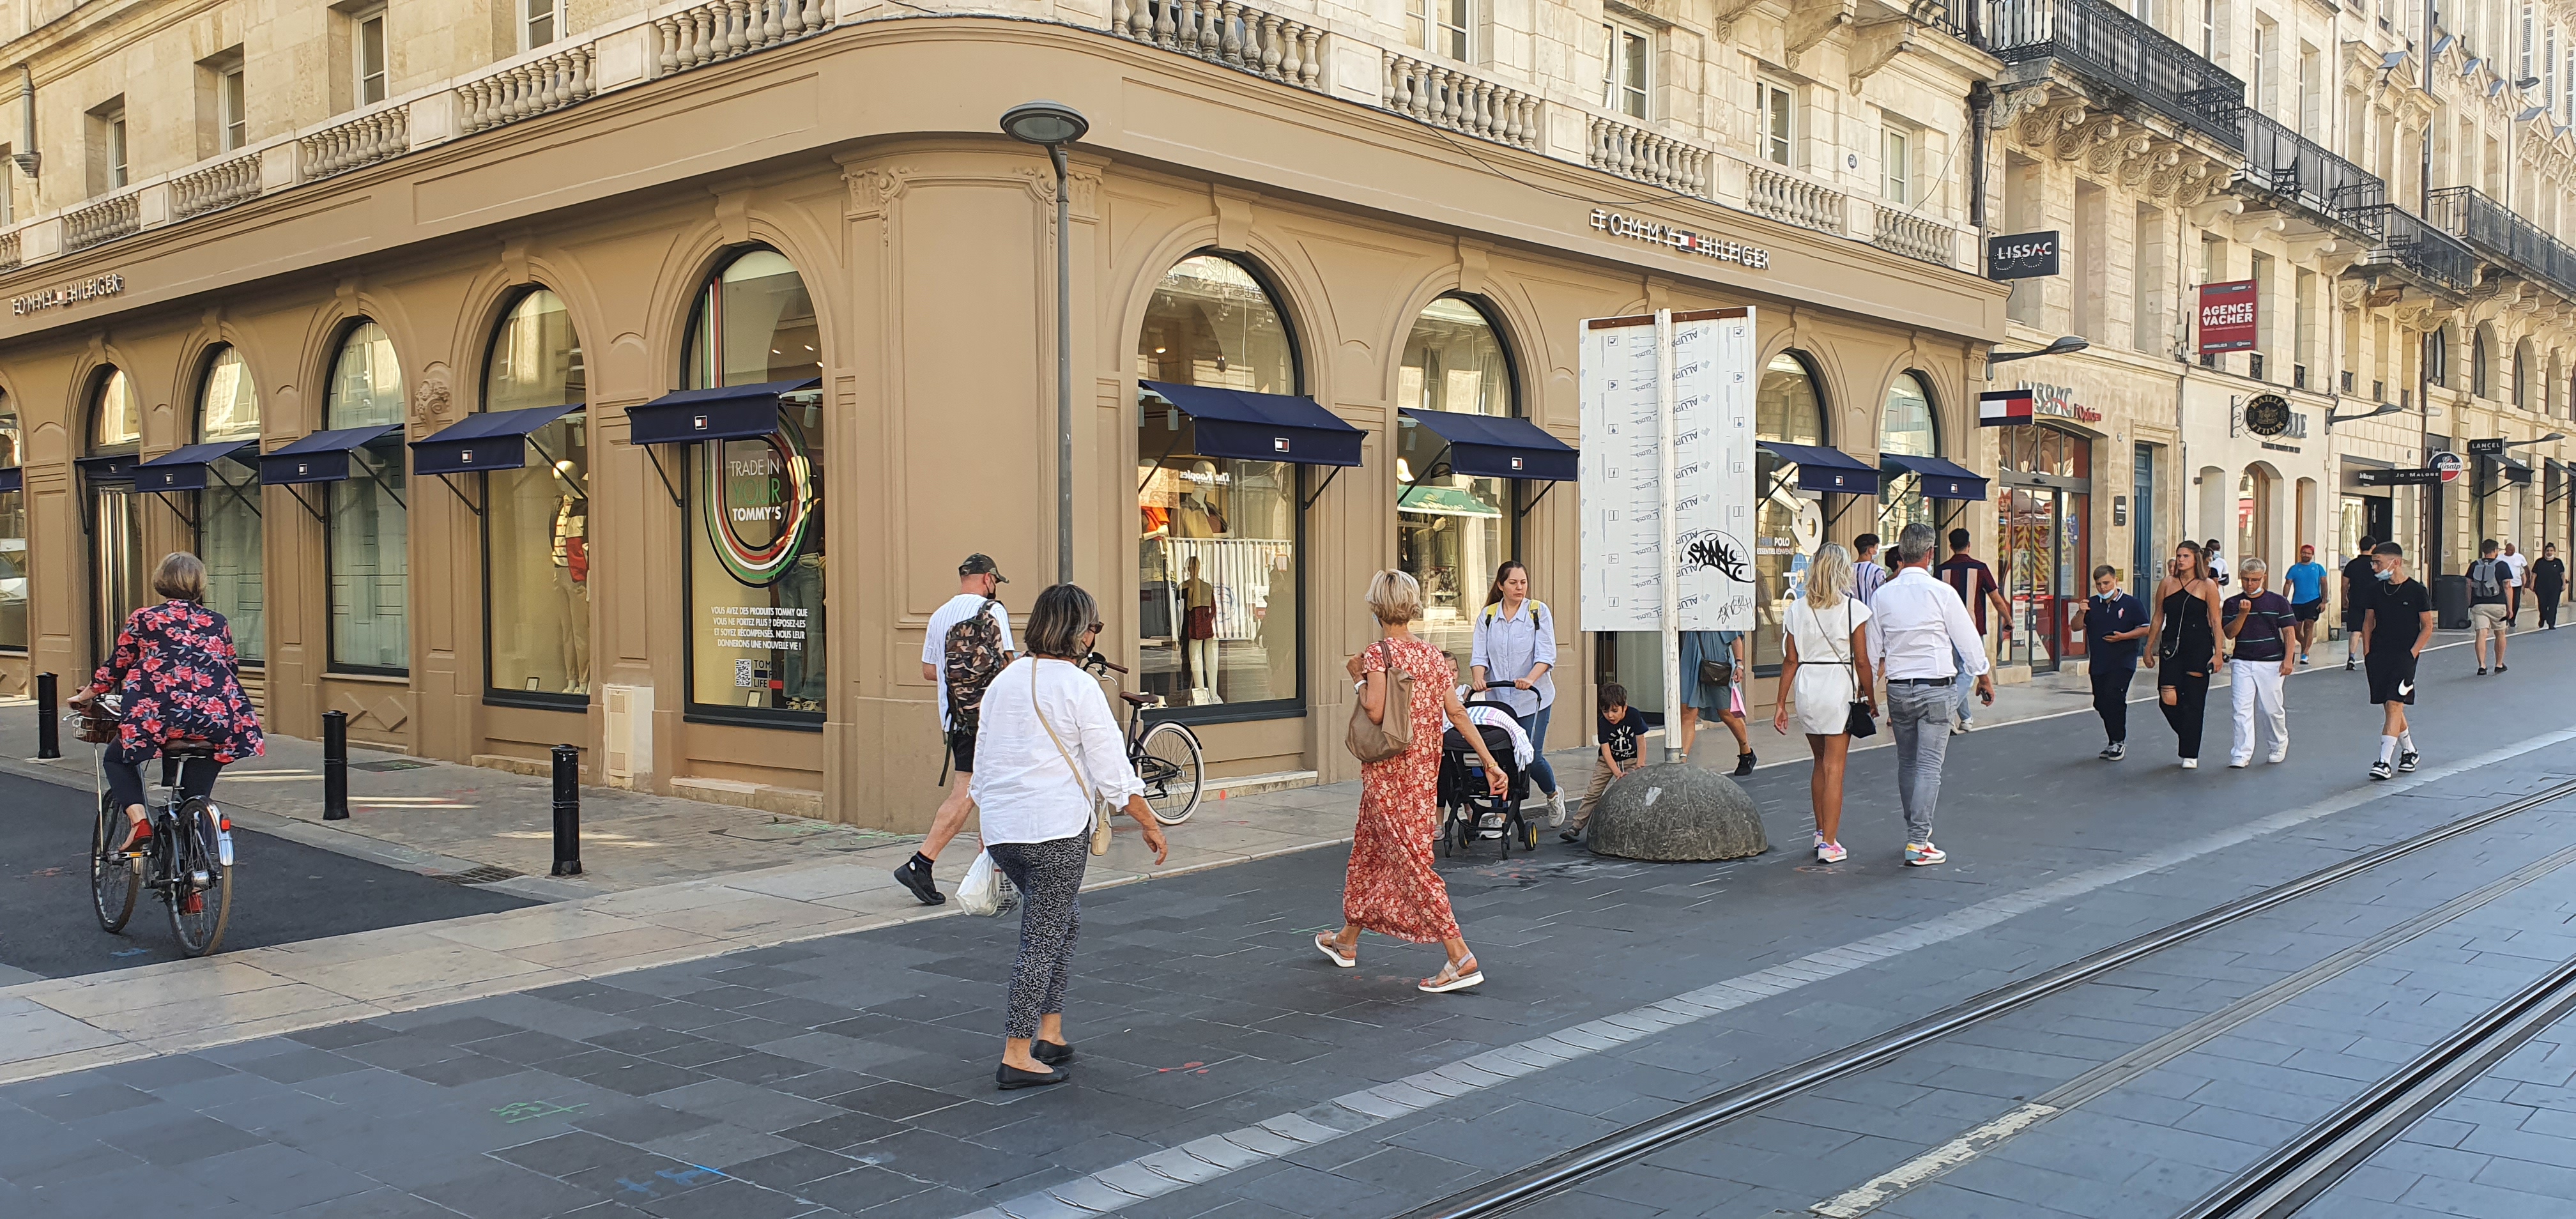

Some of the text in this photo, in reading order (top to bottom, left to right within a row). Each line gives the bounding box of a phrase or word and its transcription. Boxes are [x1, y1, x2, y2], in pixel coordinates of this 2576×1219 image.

[1595, 208, 1771, 270] TOMMY HILFIGER
[1998, 241, 2052, 259] LISSAC
[11, 273, 121, 316] TOMMY HILFIGER
[2202, 302, 2253, 316] AGENCE
[2202, 312, 2253, 326] VACHER
[2250, 396, 2285, 410] MAILLE
[2250, 421, 2285, 434] MAILLE
[730, 457, 779, 477] TRADE IN
[731, 478, 781, 505] YOUR
[732, 506, 781, 521] TOMMY'S
[1774, 537, 1790, 546] POLO
[726, 606, 739, 615] AVEZ
[749, 607, 774, 616] PRODUITS
[775, 608, 795, 616] TOMMY
[796, 608, 808, 617] QUE
[713, 617, 727, 625] VOUS
[728, 617, 735, 625] NE
[736, 618, 755, 626] PORTEZ
[755, 618, 768, 627] PLUS
[772, 617, 806, 628] DÉPOSEZ-LES
[720, 628, 736, 636] SOYEZ
[737, 627, 775, 638] RÉCOMPENSÉS.
[776, 630, 792, 638] NOUS
[792, 631, 805, 639] LEUR
[717, 639, 802, 650] DONNERONS UNE NOUVELLE VIE !
[753, 679, 767, 687] LIFE
